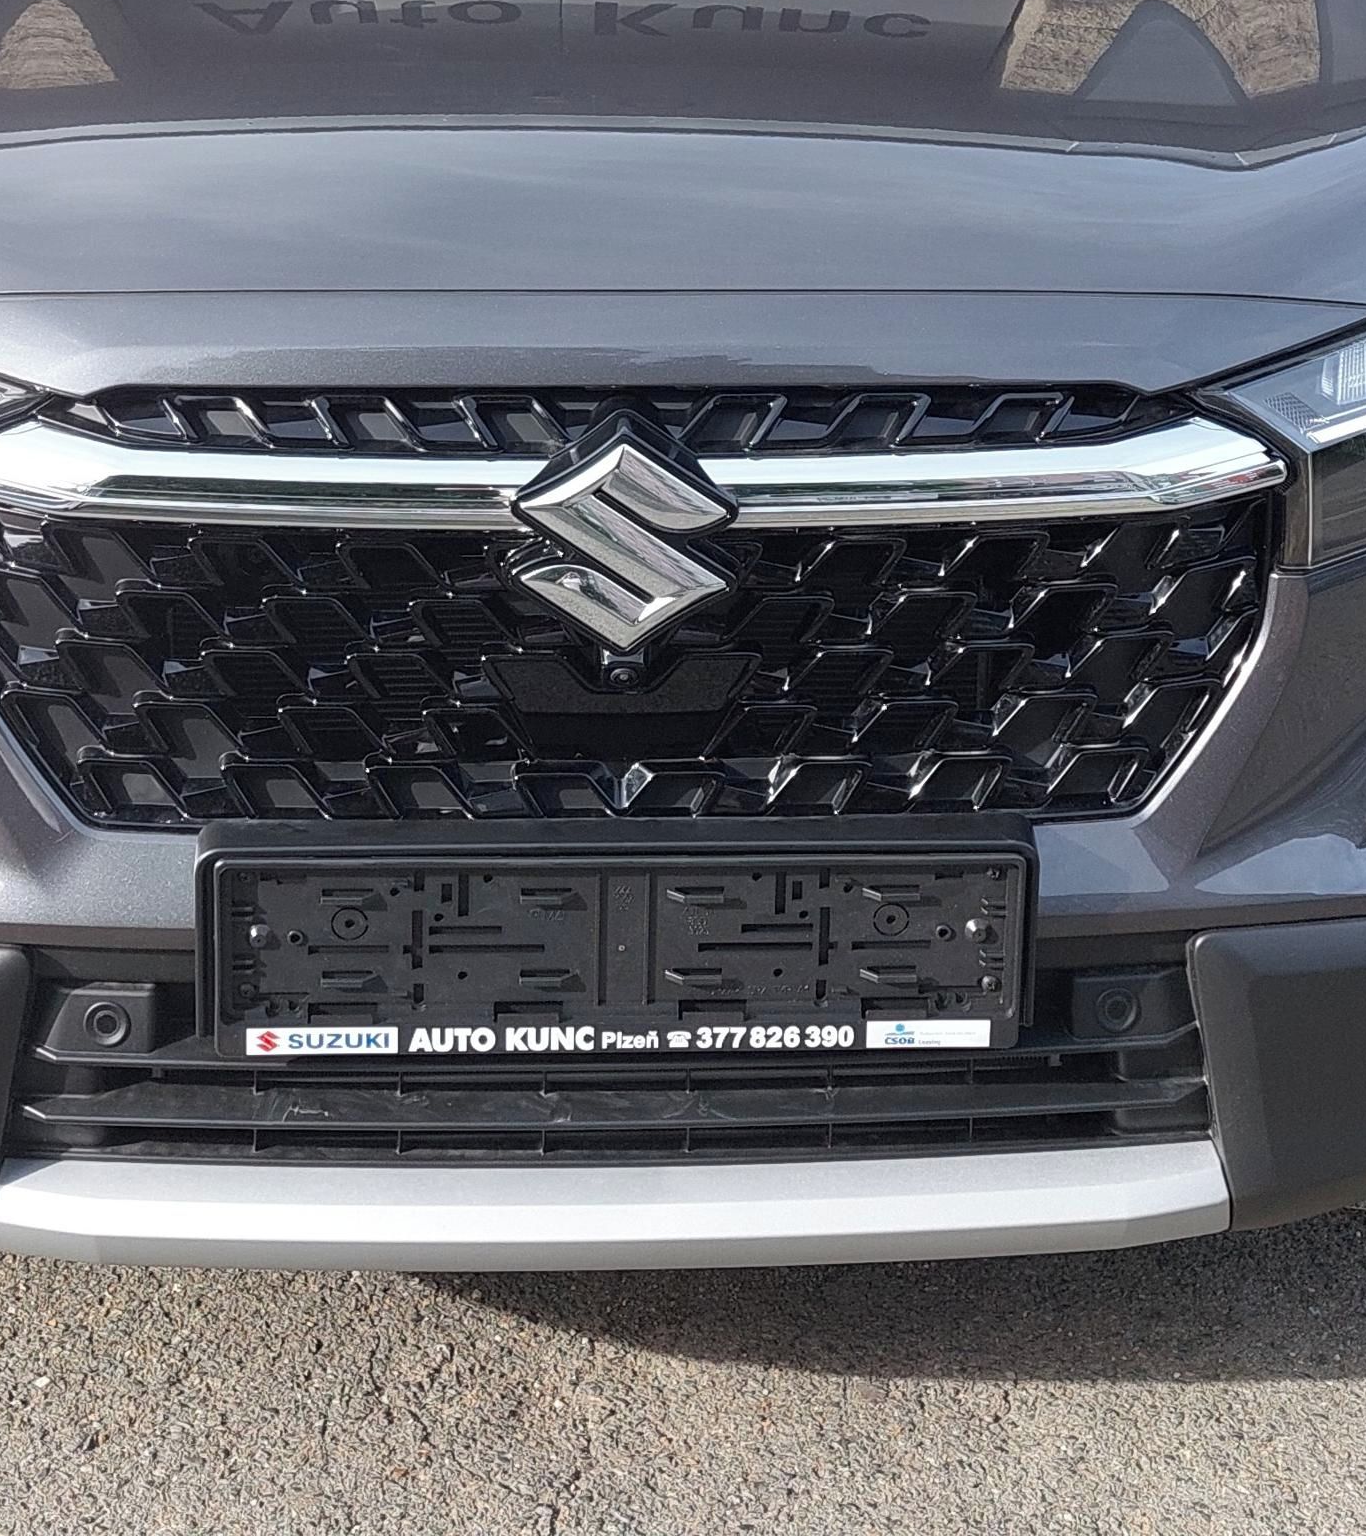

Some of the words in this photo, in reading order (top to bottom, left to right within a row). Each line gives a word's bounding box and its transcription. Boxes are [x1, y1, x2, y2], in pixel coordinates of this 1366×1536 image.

[287, 1032, 390, 1050] SUZUKI
[407, 1027, 496, 1053] AUTO
[504, 1026, 595, 1052] KUNC
[600, 1025, 659, 1050] Plzeň
[696, 1026, 748, 1050] 377
[749, 1025, 801, 1049] 826
[803, 1025, 855, 1048] 390
